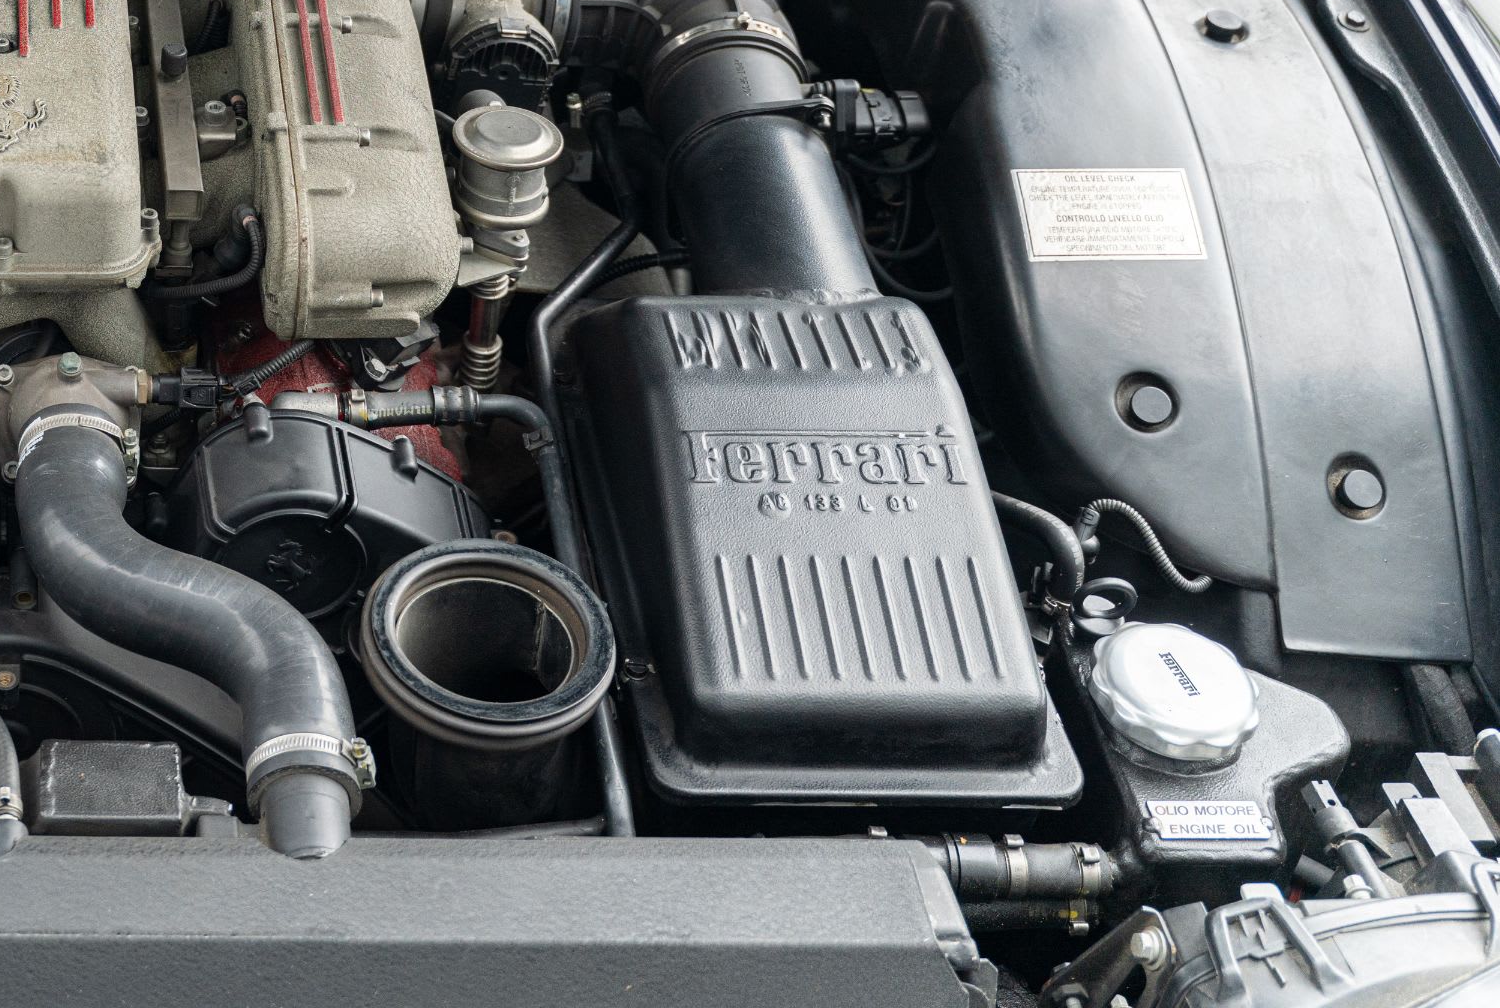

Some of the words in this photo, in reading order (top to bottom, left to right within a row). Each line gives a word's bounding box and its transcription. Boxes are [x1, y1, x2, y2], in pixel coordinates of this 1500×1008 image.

[681, 423, 968, 485] Ferrari
[1158, 652, 1201, 697] Ferrari
[1155, 805, 1189, 816] OLIO
[1194, 805, 1255, 815] MOTORE
[1170, 824, 1227, 834] ENGINE
[1235, 824, 1260, 834] OIL
